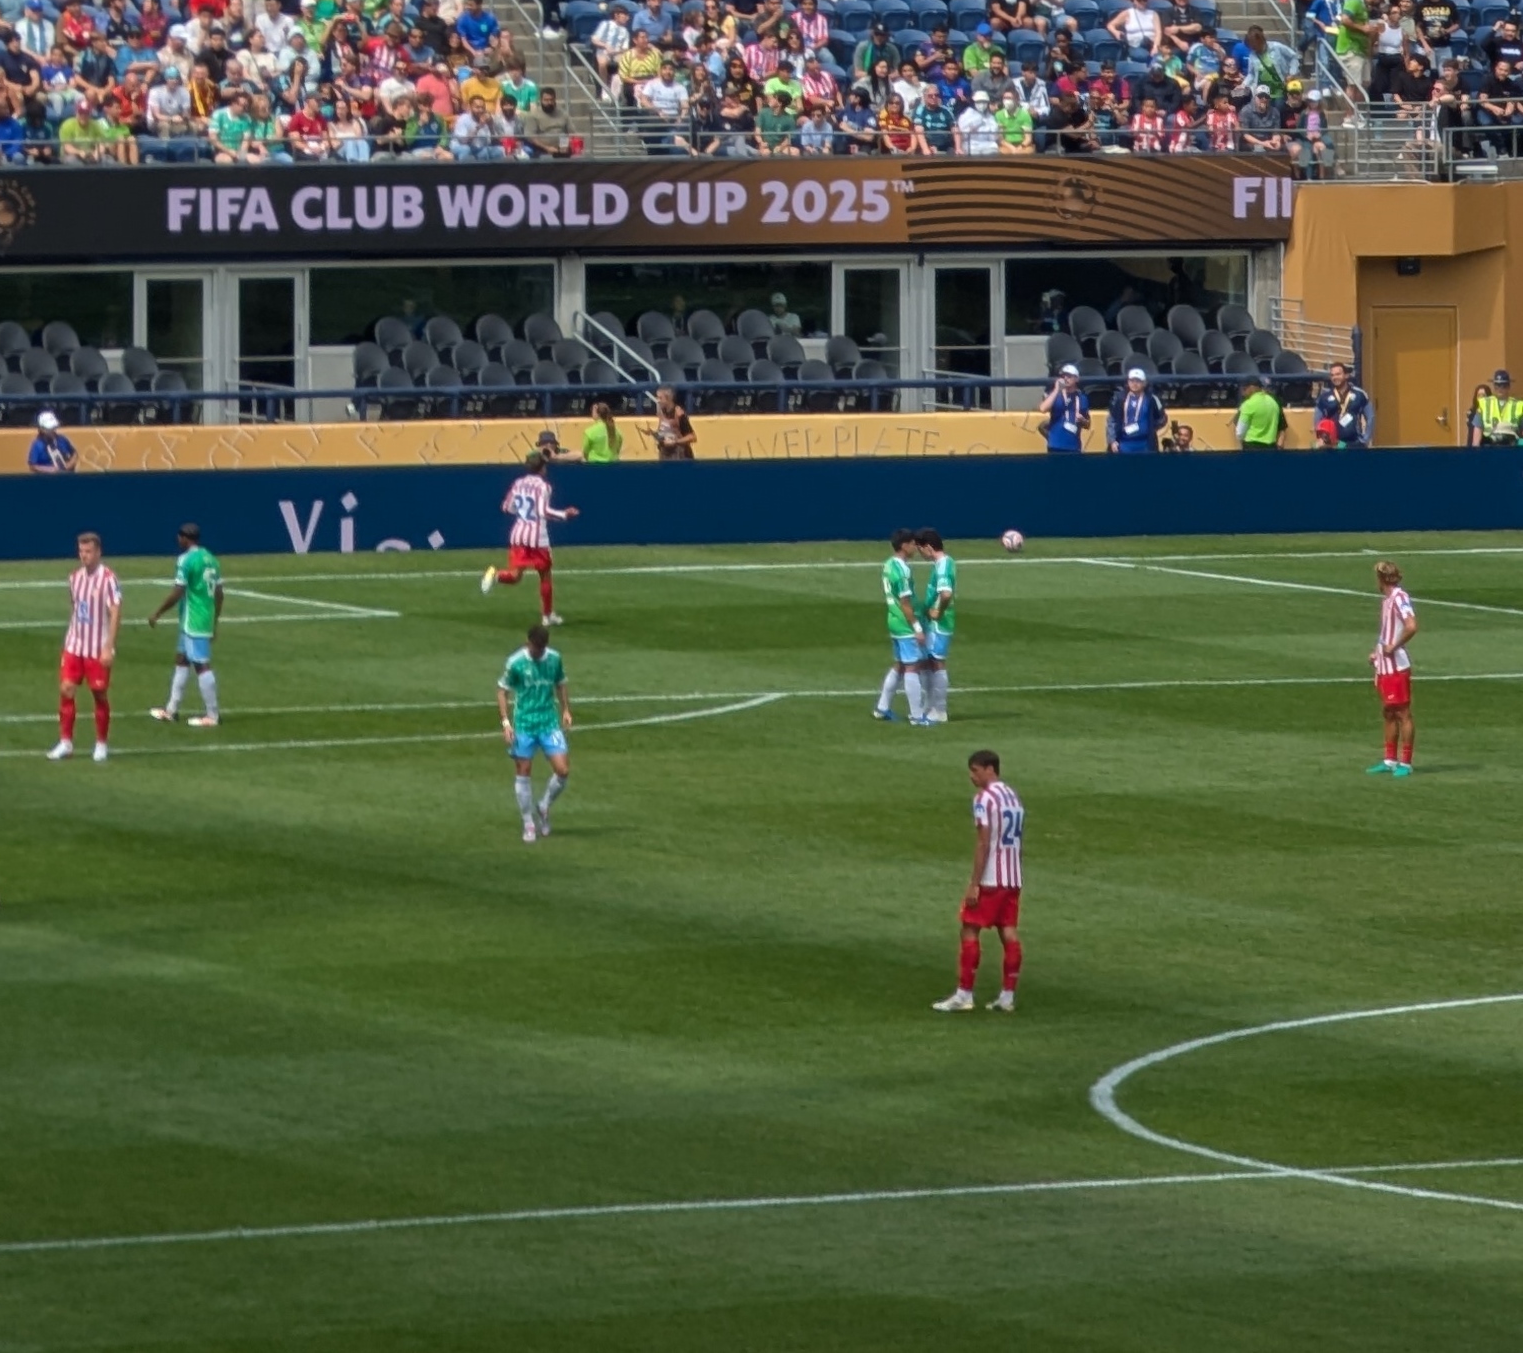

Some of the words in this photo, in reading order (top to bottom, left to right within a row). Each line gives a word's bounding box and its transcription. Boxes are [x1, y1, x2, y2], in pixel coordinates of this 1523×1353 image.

[167, 187, 279, 232] FIFA
[291, 185, 424, 230] CLUB
[436, 183, 629, 228] WORLD
[642, 180, 748, 225] CUP
[1002, 809, 1023, 845] 24
